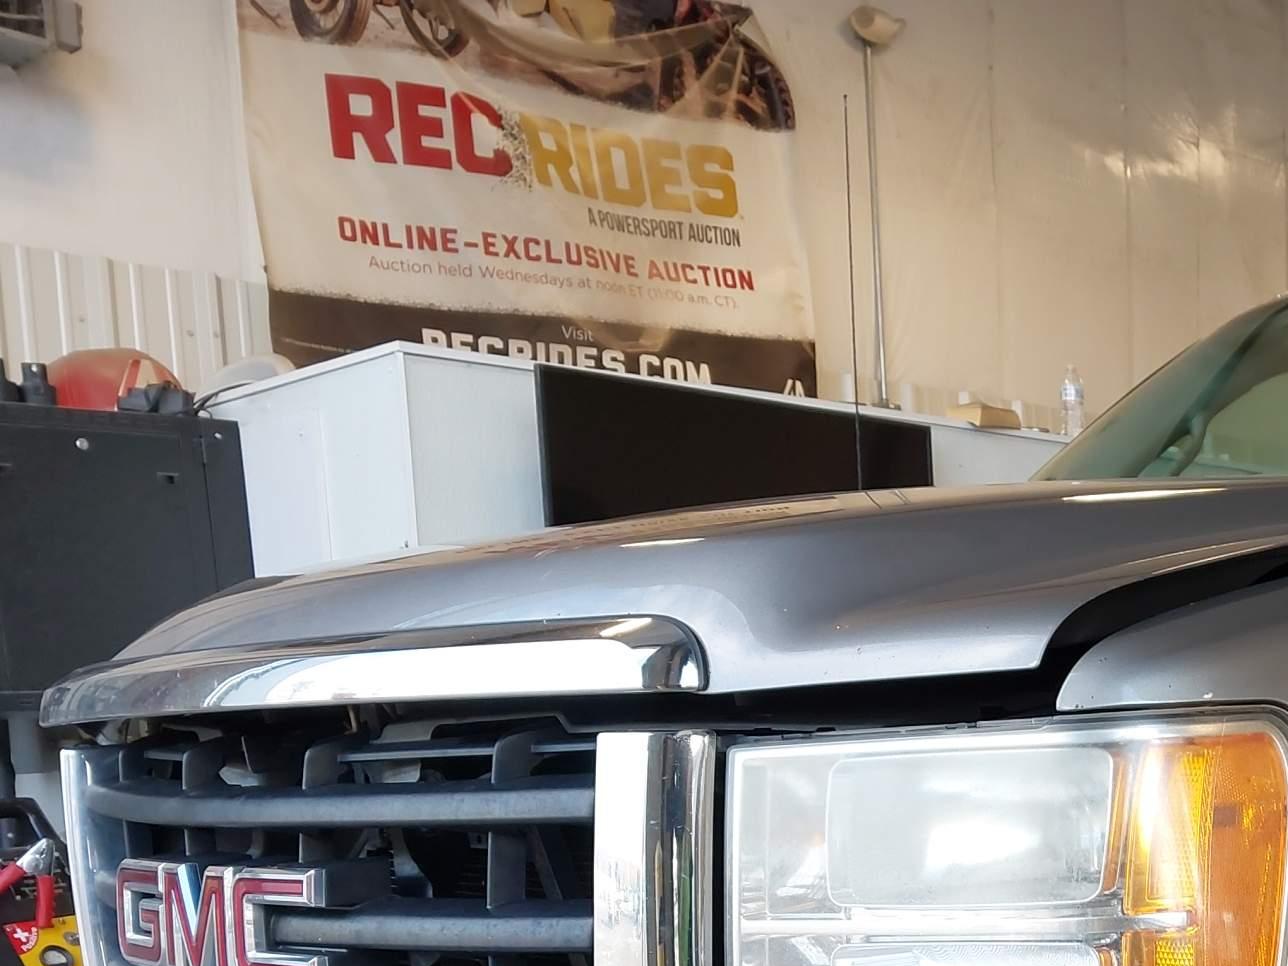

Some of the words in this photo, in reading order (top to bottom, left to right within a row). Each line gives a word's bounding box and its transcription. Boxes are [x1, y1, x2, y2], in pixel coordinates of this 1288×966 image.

[587, 207, 597, 226] A
[598, 210, 684, 241] POWERSPORT
[688, 225, 741, 248] AUCTION
[337, 215, 639, 278] ONLINE-EXCLUSIVE
[648, 259, 755, 291] AUCTION
[368, 255, 433, 275] Auction
[438, 261, 473, 278] held
[478, 264, 573, 288] Wednesdays
[577, 275, 592, 289] at
[561, 325, 594, 342] Visit
